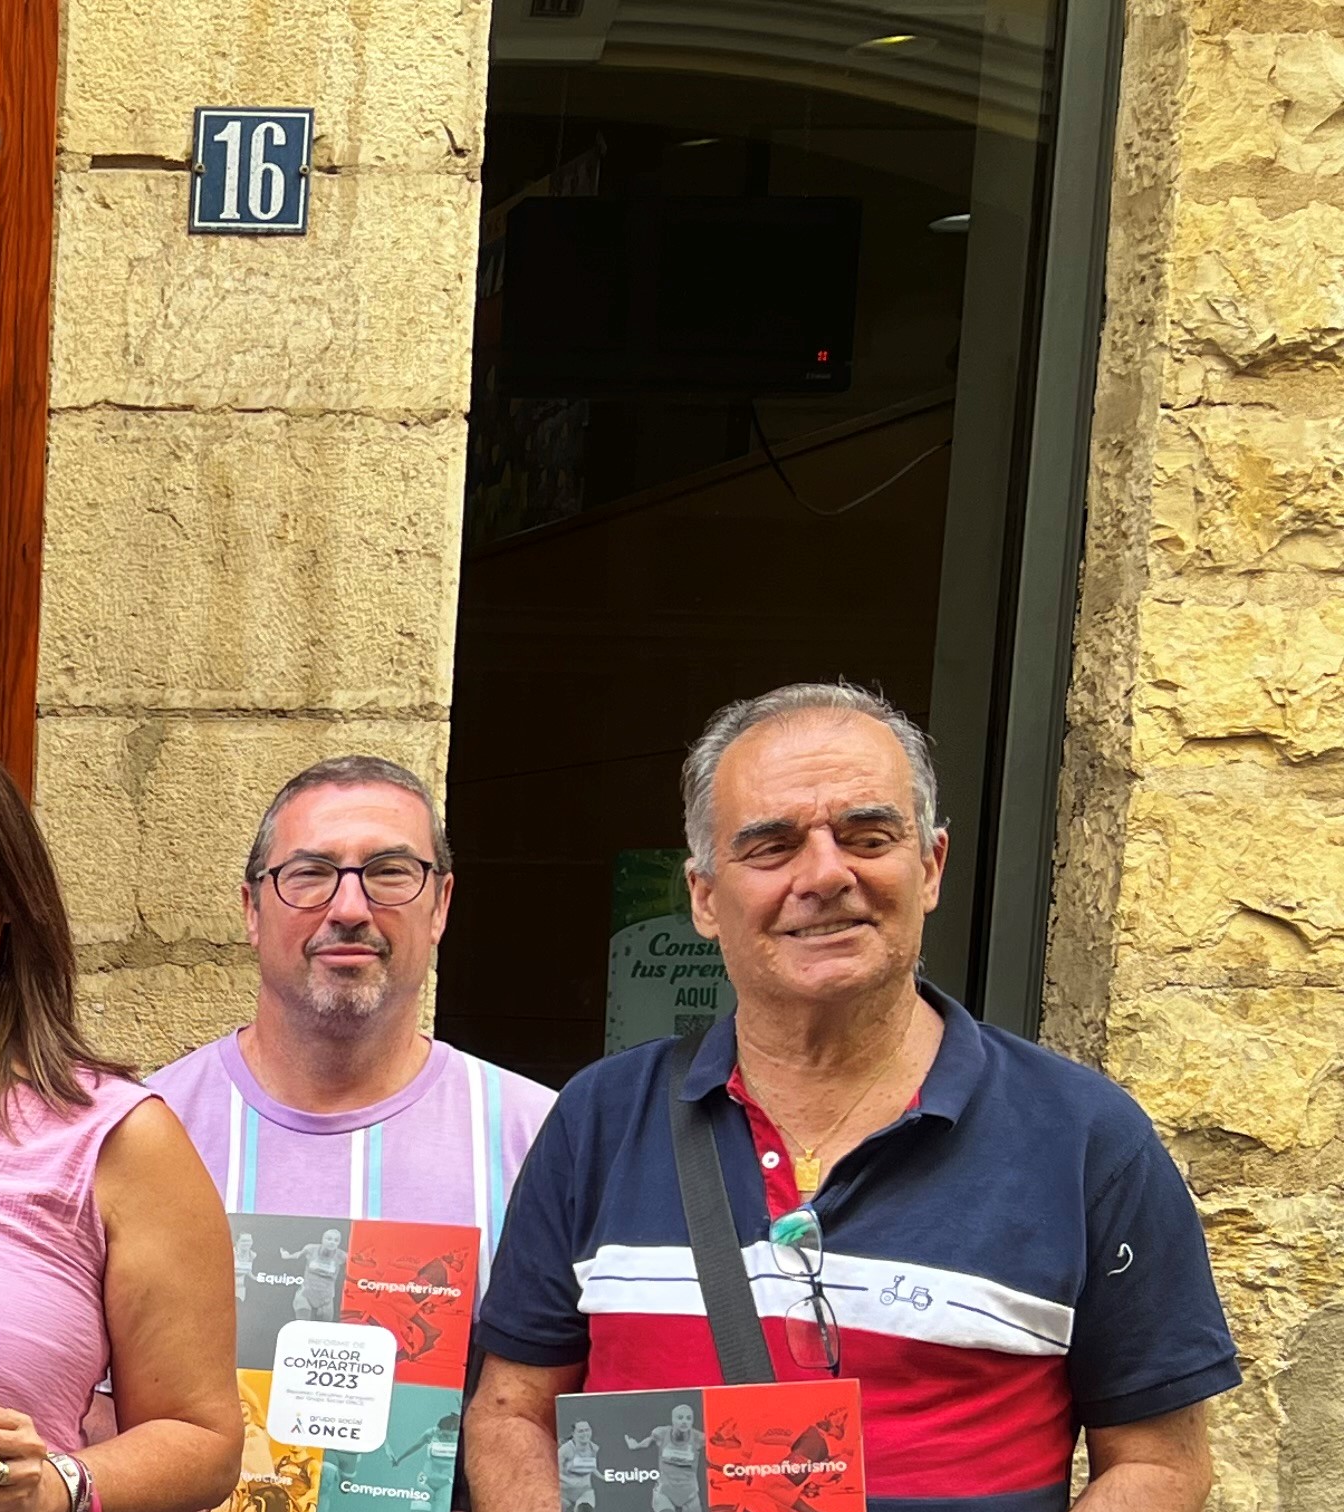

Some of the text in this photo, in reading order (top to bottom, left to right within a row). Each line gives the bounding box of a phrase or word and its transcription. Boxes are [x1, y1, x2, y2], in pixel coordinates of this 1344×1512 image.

[213, 121, 286, 220] 16
[649, 932, 721, 956] Consu
[631, 960, 728, 985] tus prem
[674, 982, 718, 1010] AQUÍ
[256, 1272, 304, 1287] Equipo
[357, 1278, 462, 1298] Compañerismo
[310, 1348, 361, 1361] VALOR
[284, 1357, 385, 1375] COMPARTIDO
[305, 1371, 359, 1389] 2023
[310, 1415, 336, 1423] grupo
[308, 1424, 361, 1440] ONCE
[603, 1467, 660, 1483] Equipo
[722, 1459, 848, 1477] Compañerismo
[340, 1480, 431, 1502] Compromiso
